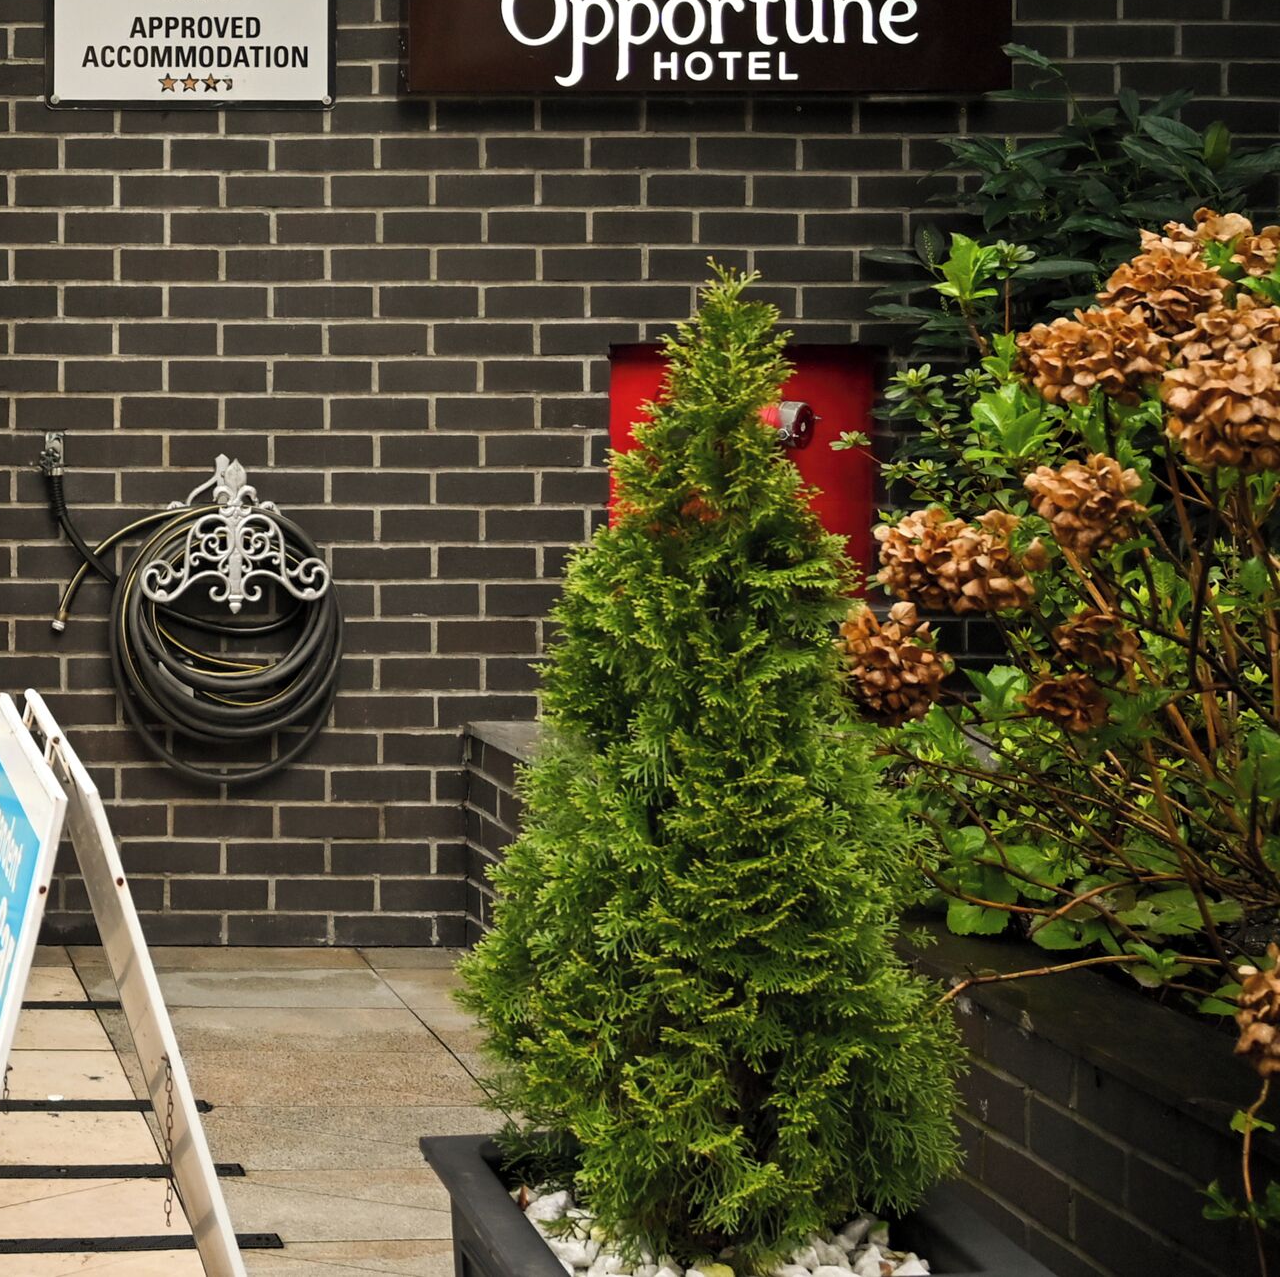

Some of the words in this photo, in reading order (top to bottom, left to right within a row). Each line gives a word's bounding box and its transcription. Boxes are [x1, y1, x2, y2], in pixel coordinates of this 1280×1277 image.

[129, 16, 262, 39] APPROVED
[81, 45, 309, 68] ACCOMMODATION
[652, 52, 799, 81] HOTEL
